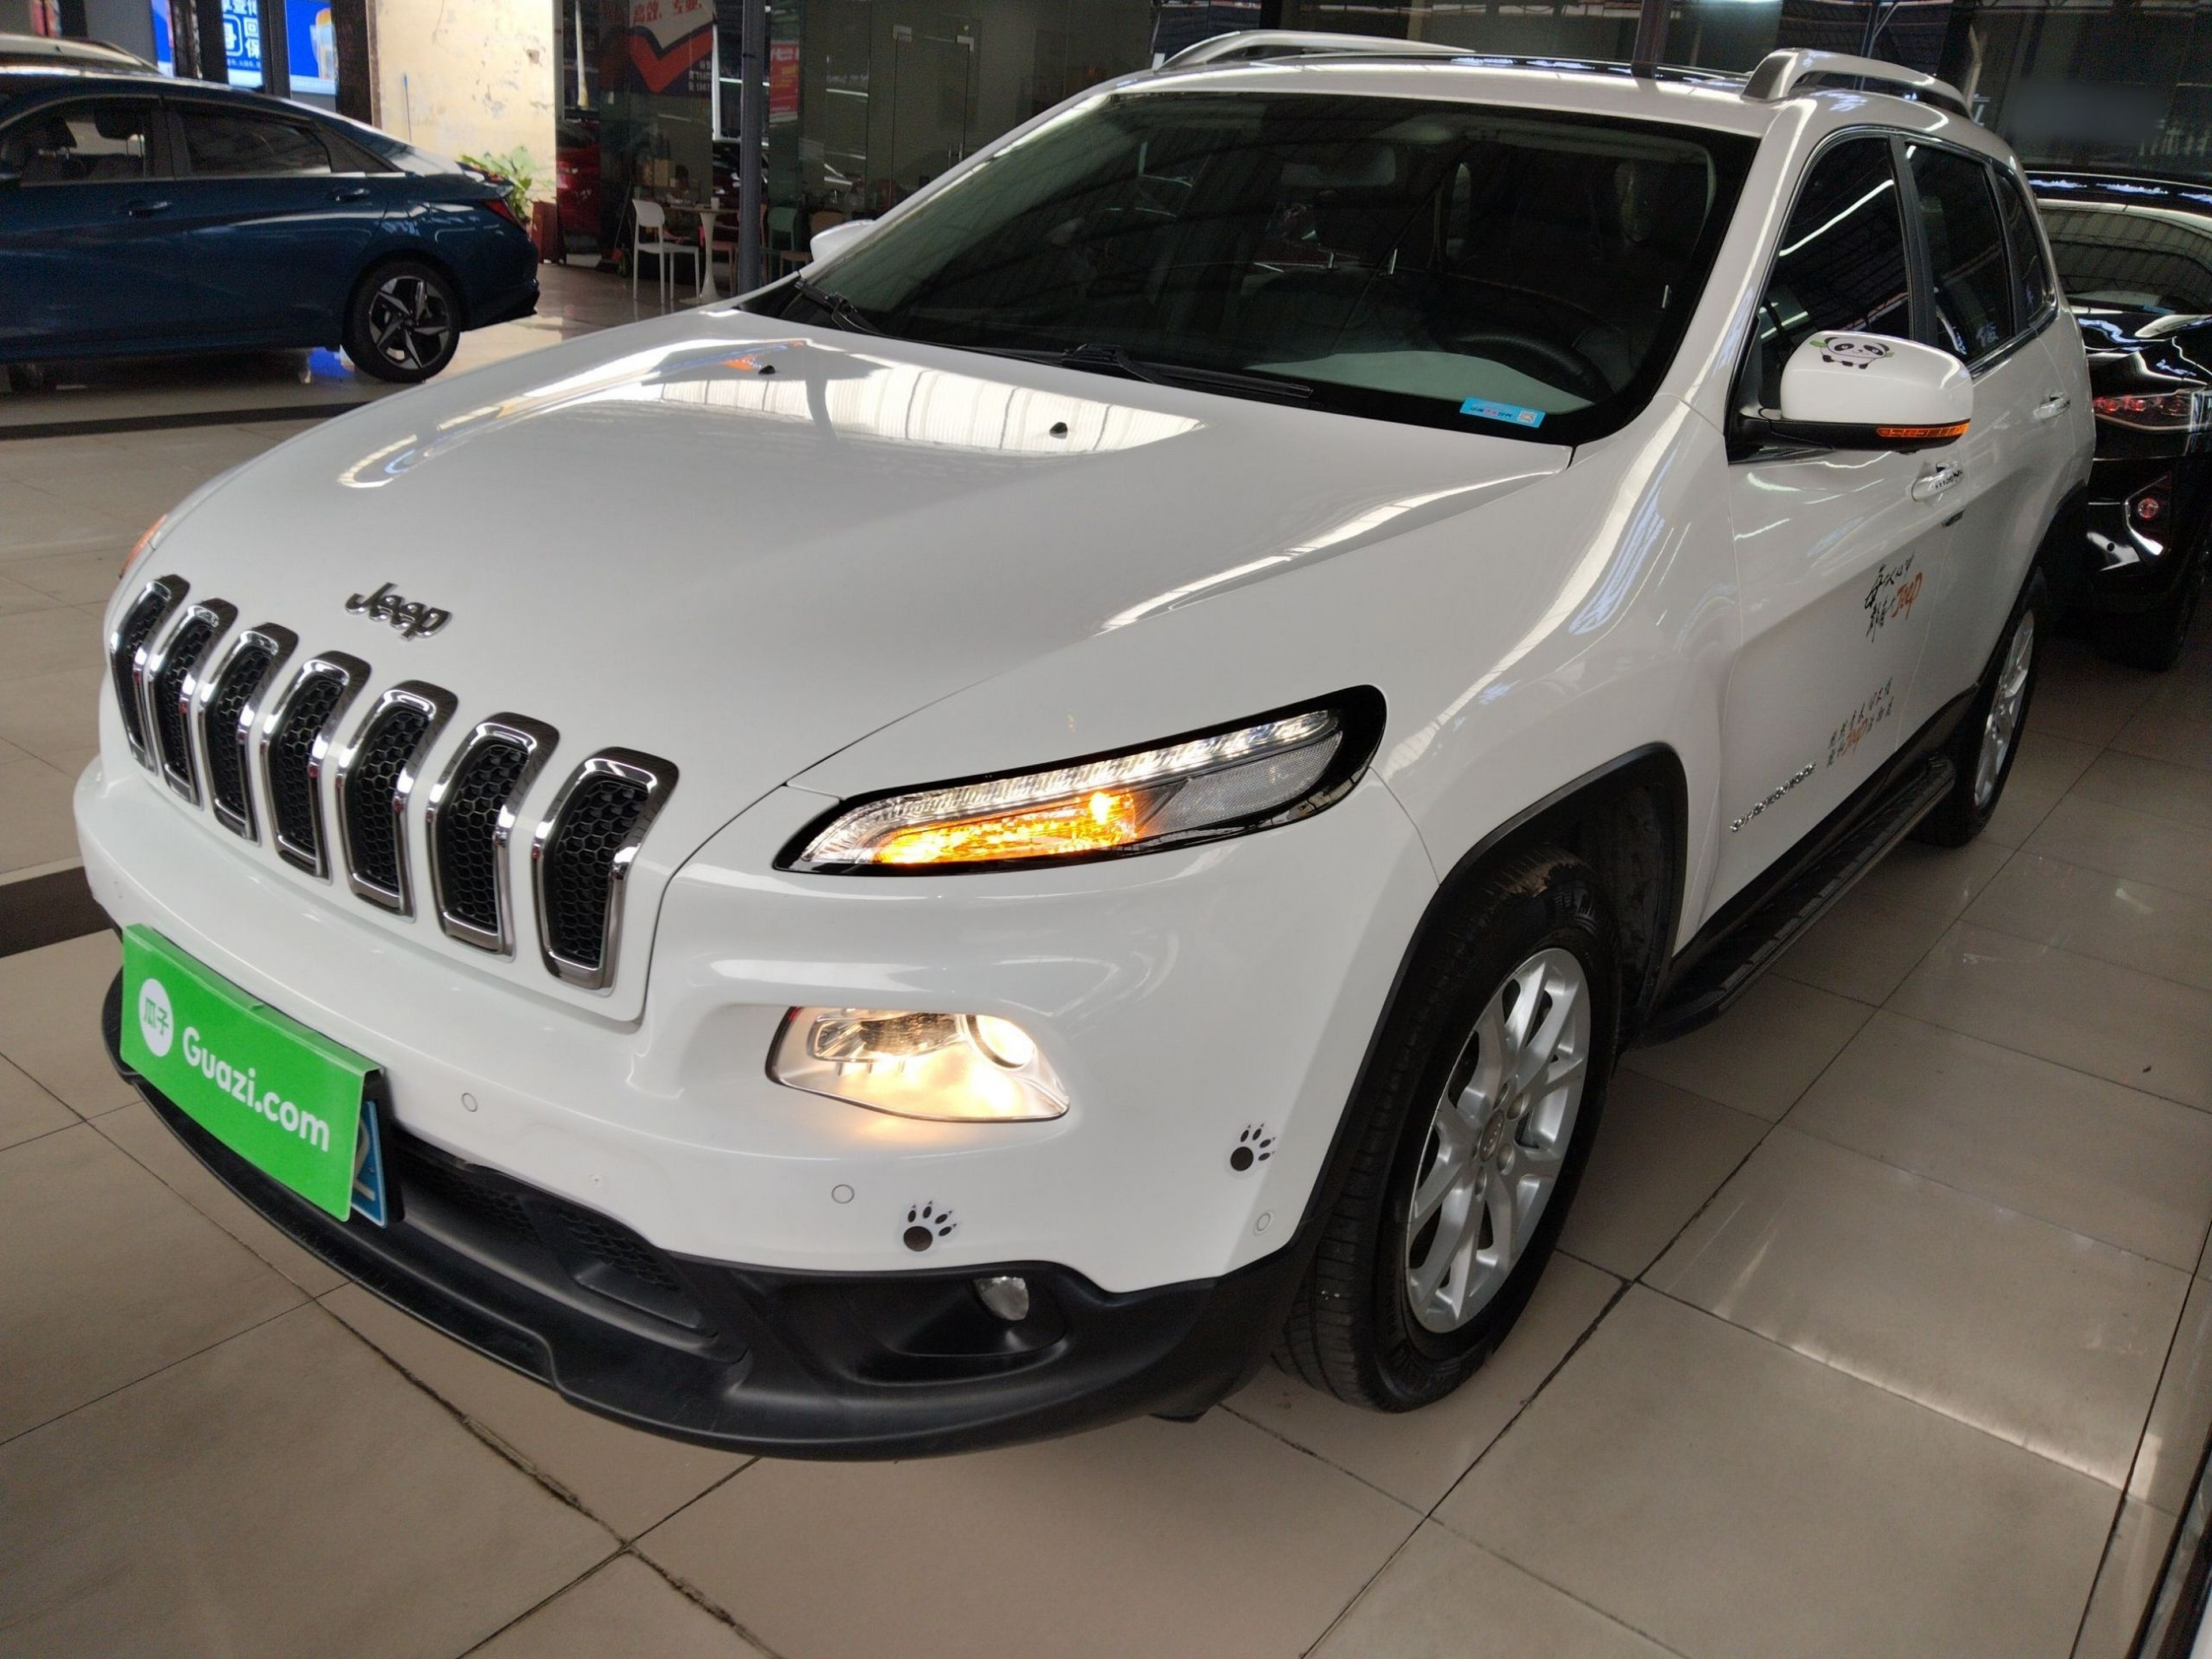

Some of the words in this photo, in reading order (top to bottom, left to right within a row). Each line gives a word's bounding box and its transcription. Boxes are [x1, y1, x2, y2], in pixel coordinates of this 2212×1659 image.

[346, 582, 452, 642] Jeep
[143, 997, 169, 1036] 瓜子
[182, 1027, 329, 1152] Guazi.com
